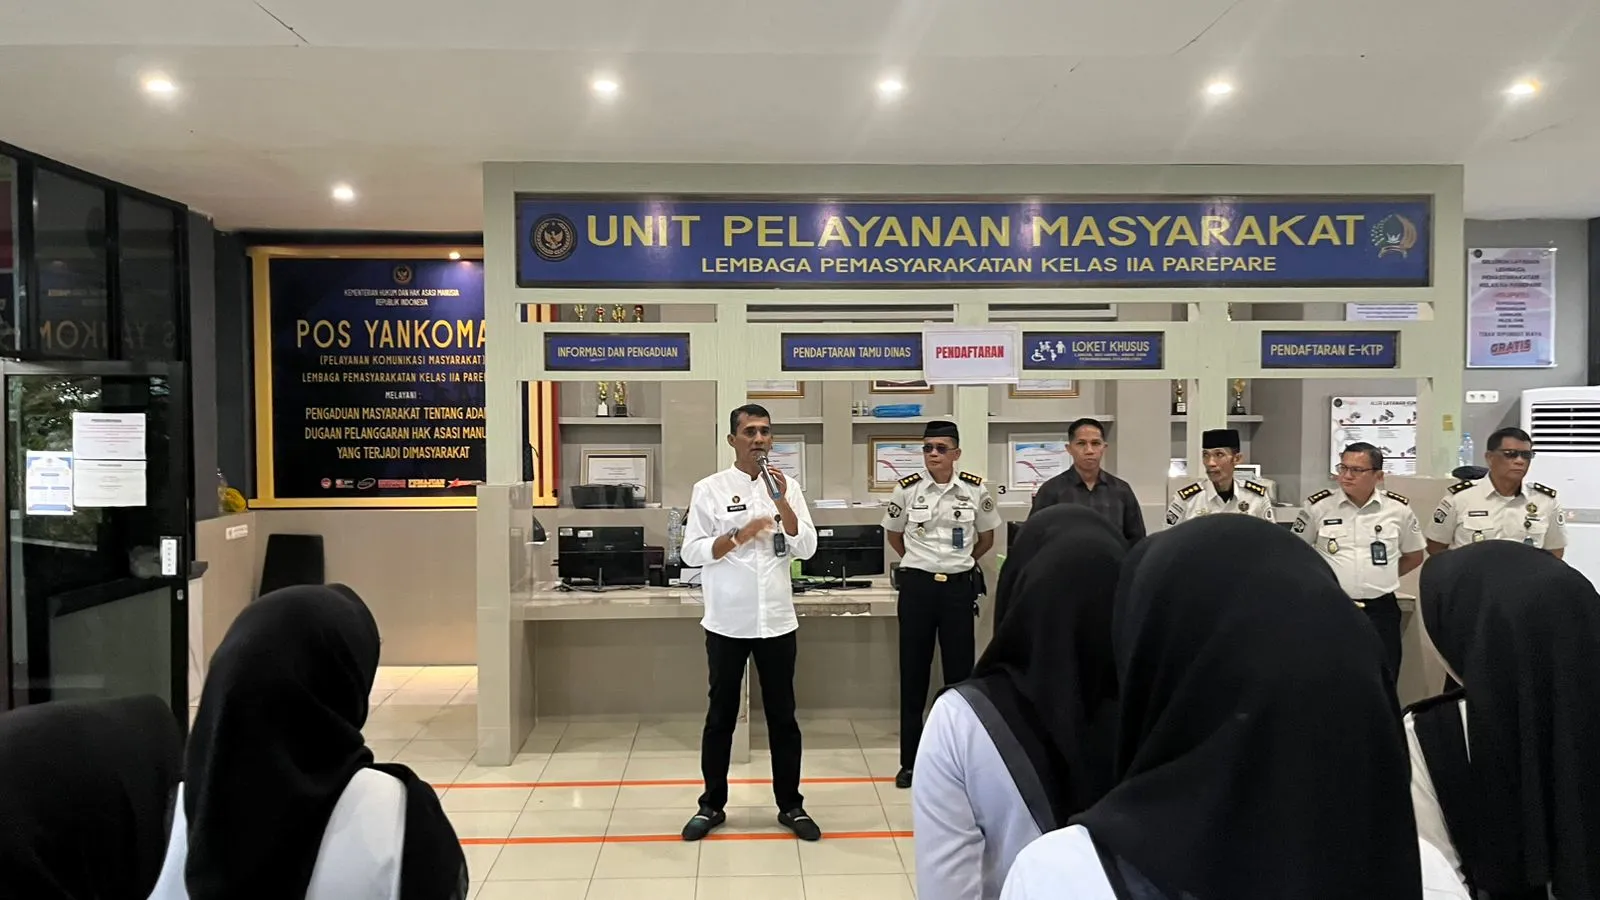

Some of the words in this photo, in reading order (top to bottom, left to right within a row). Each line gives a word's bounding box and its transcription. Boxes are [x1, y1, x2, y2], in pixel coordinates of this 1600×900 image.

[587, 215, 700, 246] UNIT
[724, 215, 1010, 247] PELAYANAN
[1033, 215, 1365, 247] MASYARAKAT
[702, 257, 811, 273] LEMBAGA
[820, 257, 1032, 273] PEMASYARAKATAN
[1041, 257, 1117, 273] KELAS
[1127, 257, 1154, 272] IIA
[1163, 257, 1276, 272] PAREPARE
[297, 320, 351, 348] POS
[558, 347, 605, 358] INFORMASI
[608, 347, 625, 358] DAN
[627, 347, 678, 358] PENGADUAN
[793, 347, 855, 358] PENDAFTARAN
[858, 347, 882, 358] TAMU
[884, 347, 911, 358] DINAS
[936, 345, 1004, 359] PENDAFTARAN
[1072, 341, 1107, 352] LOKET
[1109, 341, 1150, 352] KHUSUS
[1270, 344, 1346, 356] PENDAFTARAN
[1348, 344, 1384, 356] E-KTP
[1490, 339, 1531, 355] GRATIS
[320, 355, 369, 366] (PELAYANAN
[372, 355, 425, 365] KOMUNIKASI
[302, 373, 340, 383] LEMBAGA
[343, 373, 416, 382] PEMASYARAKATAN
[420, 373, 446, 382] KELAS
[385, 391, 417, 399] MELAYANI
[305, 407, 359, 420] PENGADUAN
[362, 407, 420, 420] MASYARAKAT
[424, 407, 463, 420] TENTANG
[305, 427, 342, 439] DUGAAN
[344, 427, 409, 440] PELANGGARAN
[412, 427, 430, 439] HAK
[434, 427, 460, 439] ASASI
[337, 446, 360, 459] YANG
[364, 446, 400, 459] TERJADI
[403, 446, 470, 459] DIMASYARAKAT
[998, 485, 1006, 495] 3
